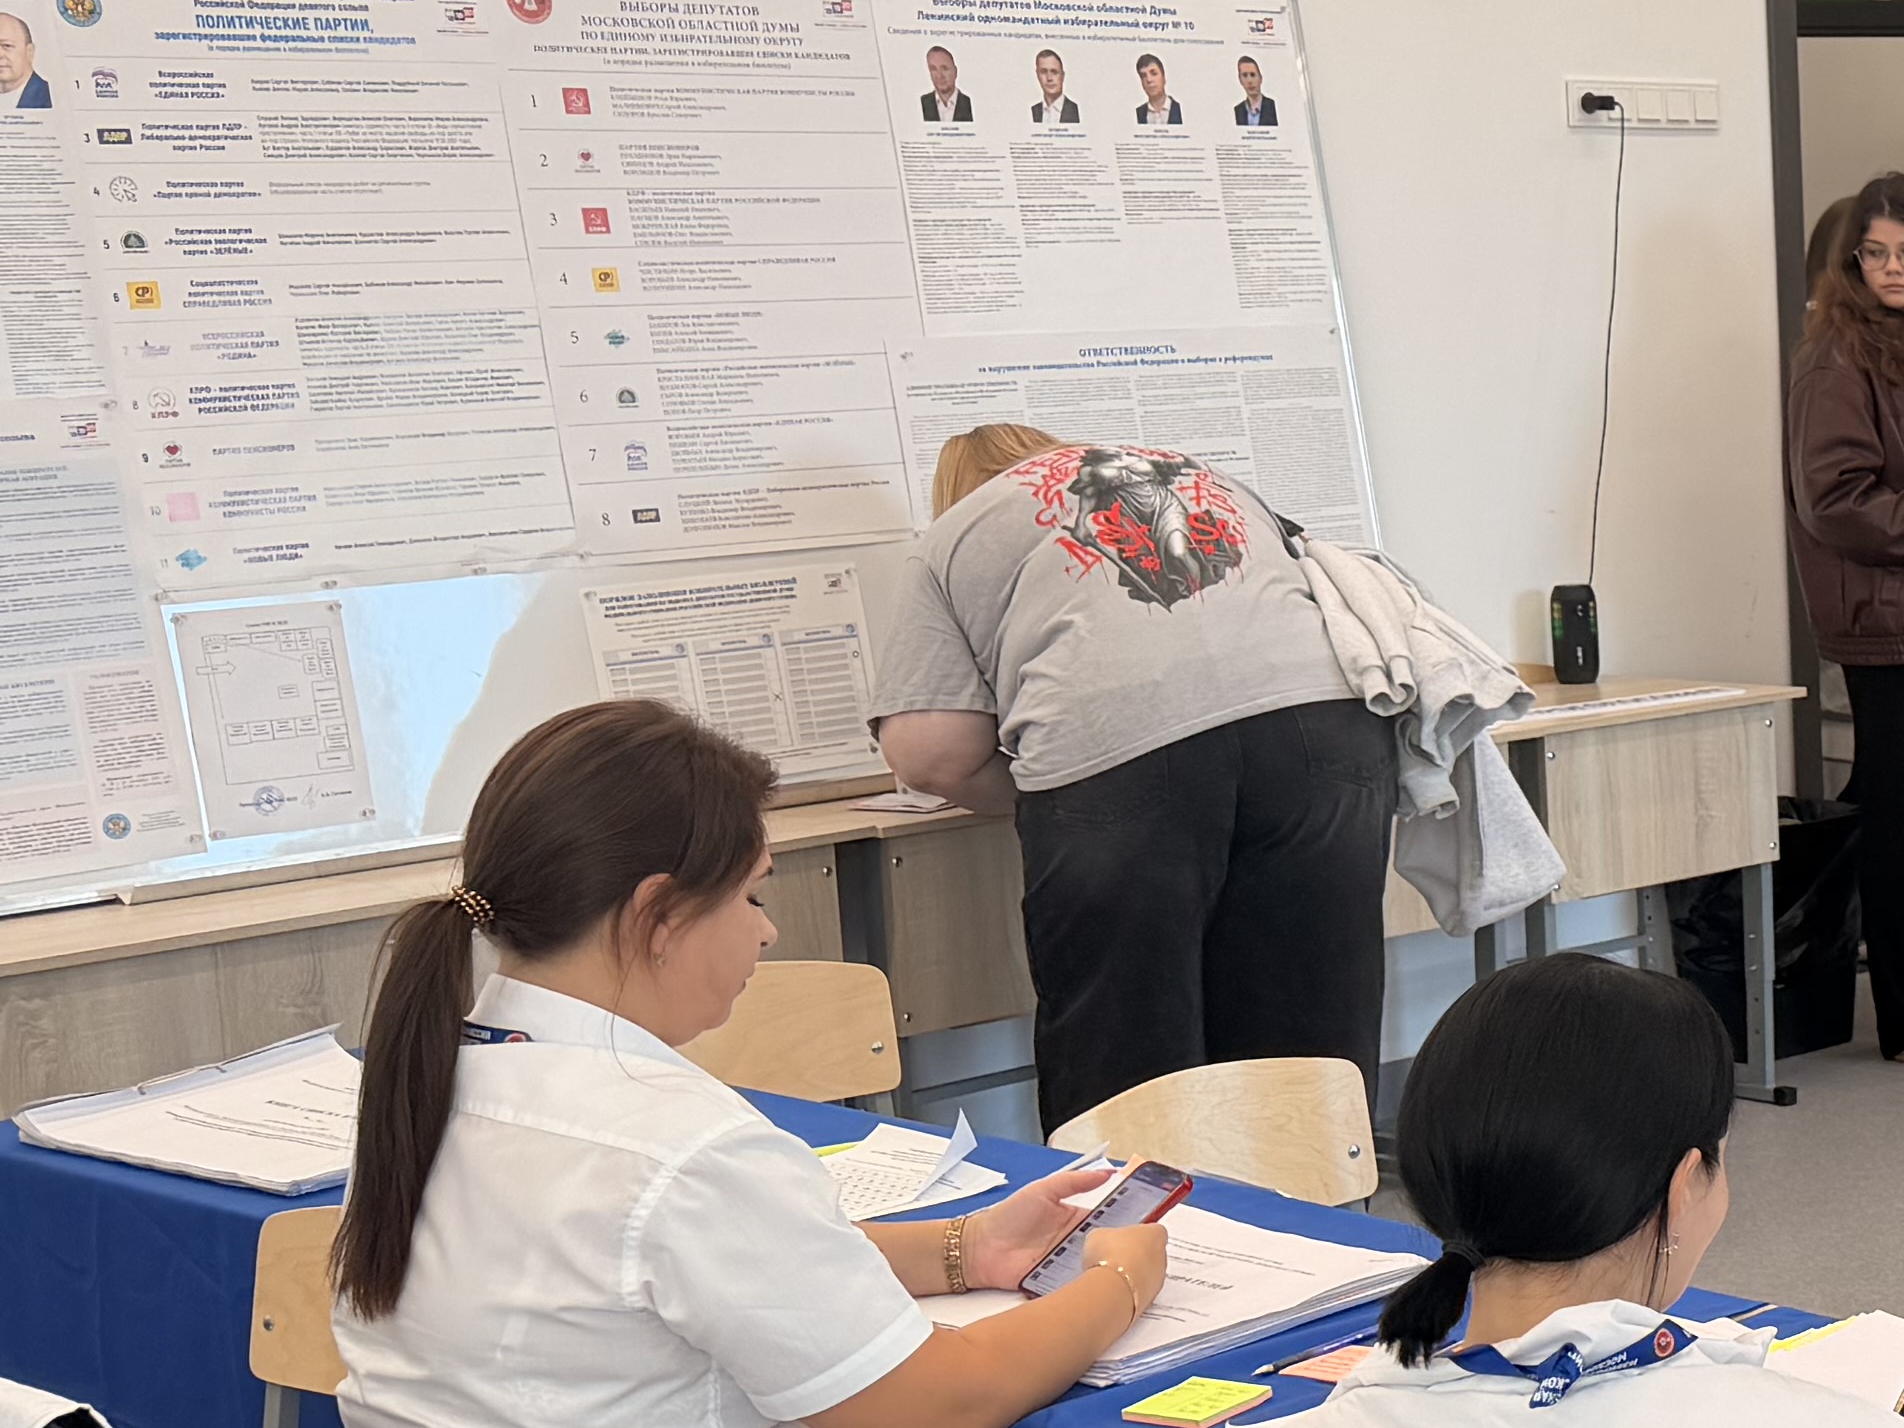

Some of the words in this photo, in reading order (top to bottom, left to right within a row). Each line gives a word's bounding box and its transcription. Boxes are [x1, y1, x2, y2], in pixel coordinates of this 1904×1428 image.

[620, 1, 679, 13] ВЫБОРЫ
[682, 3, 760, 16] ДЕПУТАТОВ
[979, 0, 1031, 11] депутатов
[1033, 0, 1094, 12] Московской
[1097, 4, 1147, 15] областной
[1149, 5, 1177, 17] Думы
[196, 14, 309, 31] ПОЛИТИЧЕСКИЕ
[315, 17, 374, 34] ПАРТИИ,
[581, 15, 675, 30] МОСКОВСКОЙ
[678, 19, 758, 33] ОБЛАСТНОЙ
[762, 22, 800, 34] ДУМЫ
[917, 11, 975, 22] Ленинский
[977, 14, 1061, 26] одномандатный
[1063, 19, 1140, 30] избирательный
[581, 31, 598, 40] ПО
[600, 31, 656, 42] ЕДИНОМУ
[659, 33, 761, 46] ИЗБИРАТЕЛЬНОМУ
[763, 36, 804, 47] ОКРУГУ
[75, 80, 80, 90] 1
[531, 94, 537, 107] 1
[539, 154, 548, 167] 2
[550, 213, 557, 226] 3
[103, 240, 110, 249] 5
[559, 272, 568, 285] 4
[570, 331, 579, 344] 5
[1079, 345, 1176, 357] ОТВЕТСТВЕННОСТЬ
[580, 389, 588, 403] 6
[142, 453, 149, 463] 9
[588, 448, 597, 461] 7
[602, 512, 610, 526] 8
